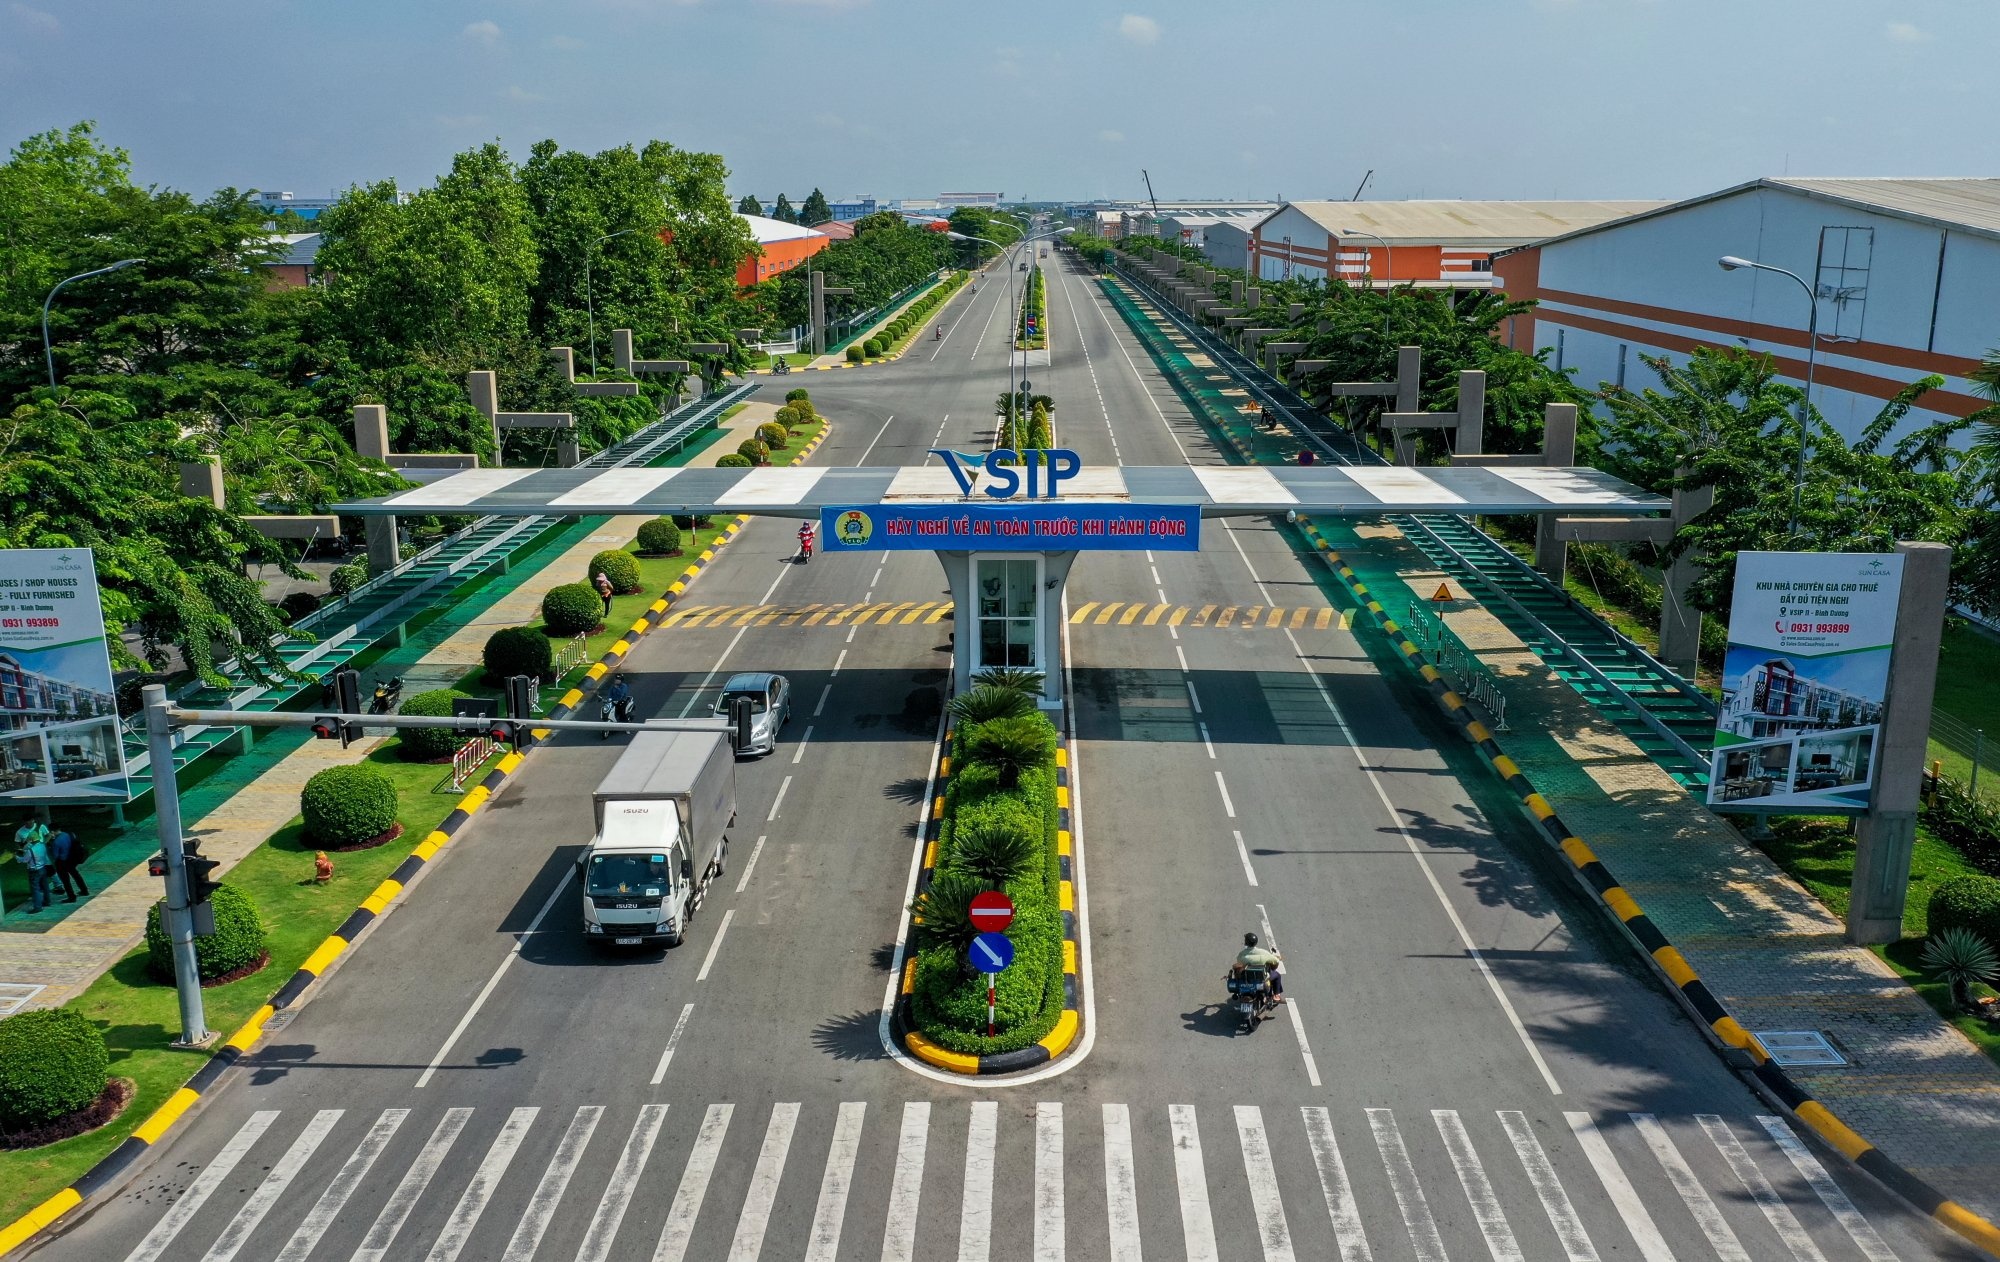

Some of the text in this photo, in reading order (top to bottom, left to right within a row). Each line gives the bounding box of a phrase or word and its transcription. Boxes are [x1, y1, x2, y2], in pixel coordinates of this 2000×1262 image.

[927, 448, 1081, 499] VSIP
[886, 516, 913, 536] HÃY
[952, 514, 969, 536] VỀ
[973, 519, 992, 536] AN
[994, 516, 1030, 536] TOÀN
[1033, 516, 1078, 536] TRƯỚC
[1081, 519, 1105, 536] KHI
[1108, 516, 1145, 536] HÀNH
[1148, 516, 1187, 539] ĐỘNG
[25, 578, 45, 587] SHOP
[48, 578, 78, 587] HOUSES
[1756, 580, 1879, 592] KHU NHÀ CHUYÊN GIA CHO THUÊ
[9, 592, 30, 600] FULLY
[32, 591, 75, 600] FURNISHED
[1830, 596, 1849, 604] NGHI
[2, 618, 59, 628] 0931 993899
[1791, 624, 1850, 633] 0931 993899
